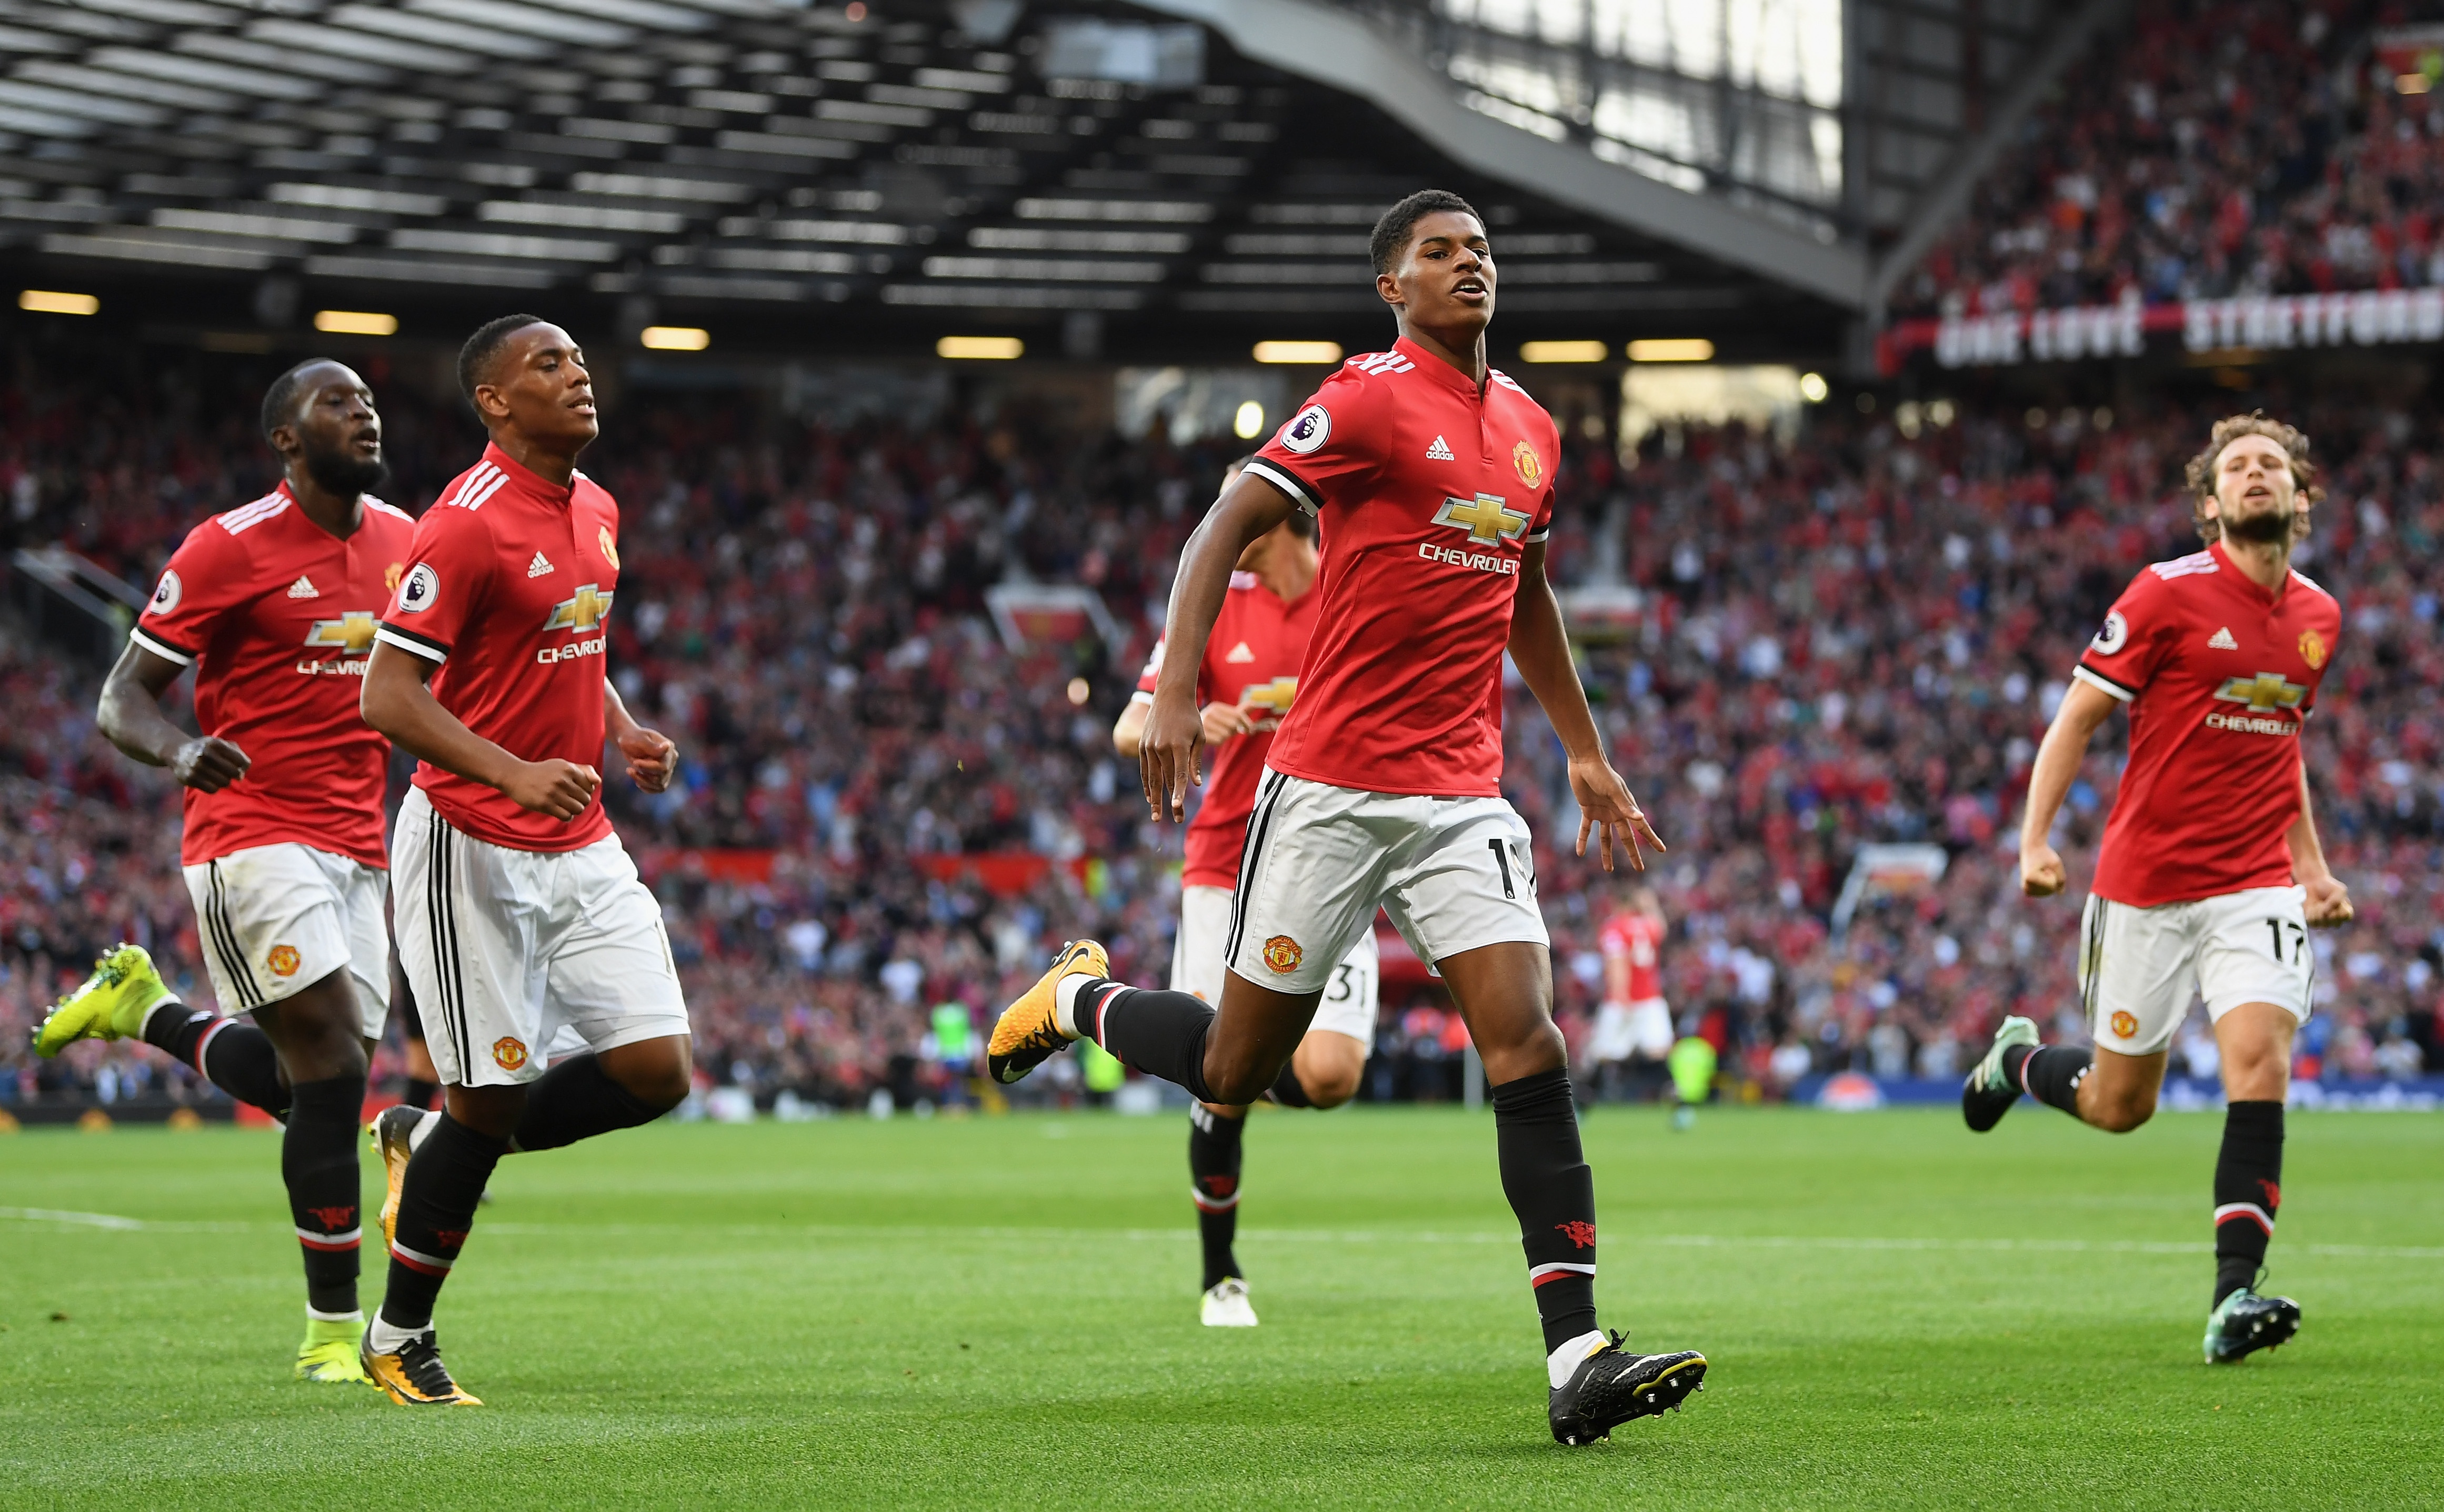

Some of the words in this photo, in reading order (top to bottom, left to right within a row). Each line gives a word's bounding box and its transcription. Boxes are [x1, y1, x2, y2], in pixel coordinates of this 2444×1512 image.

[1425, 449, 1455, 461] adidas
[1418, 542, 1517, 575] CHEVROLET
[527, 563, 555, 579] adidas
[2205, 712, 2299, 737] CHEVROLET
[1268, 937, 1299, 954] MANCHESTER
[2266, 918, 2304, 966] 17
[1269, 961, 1291, 971] UNITED
[1327, 964, 1366, 1008] 31
